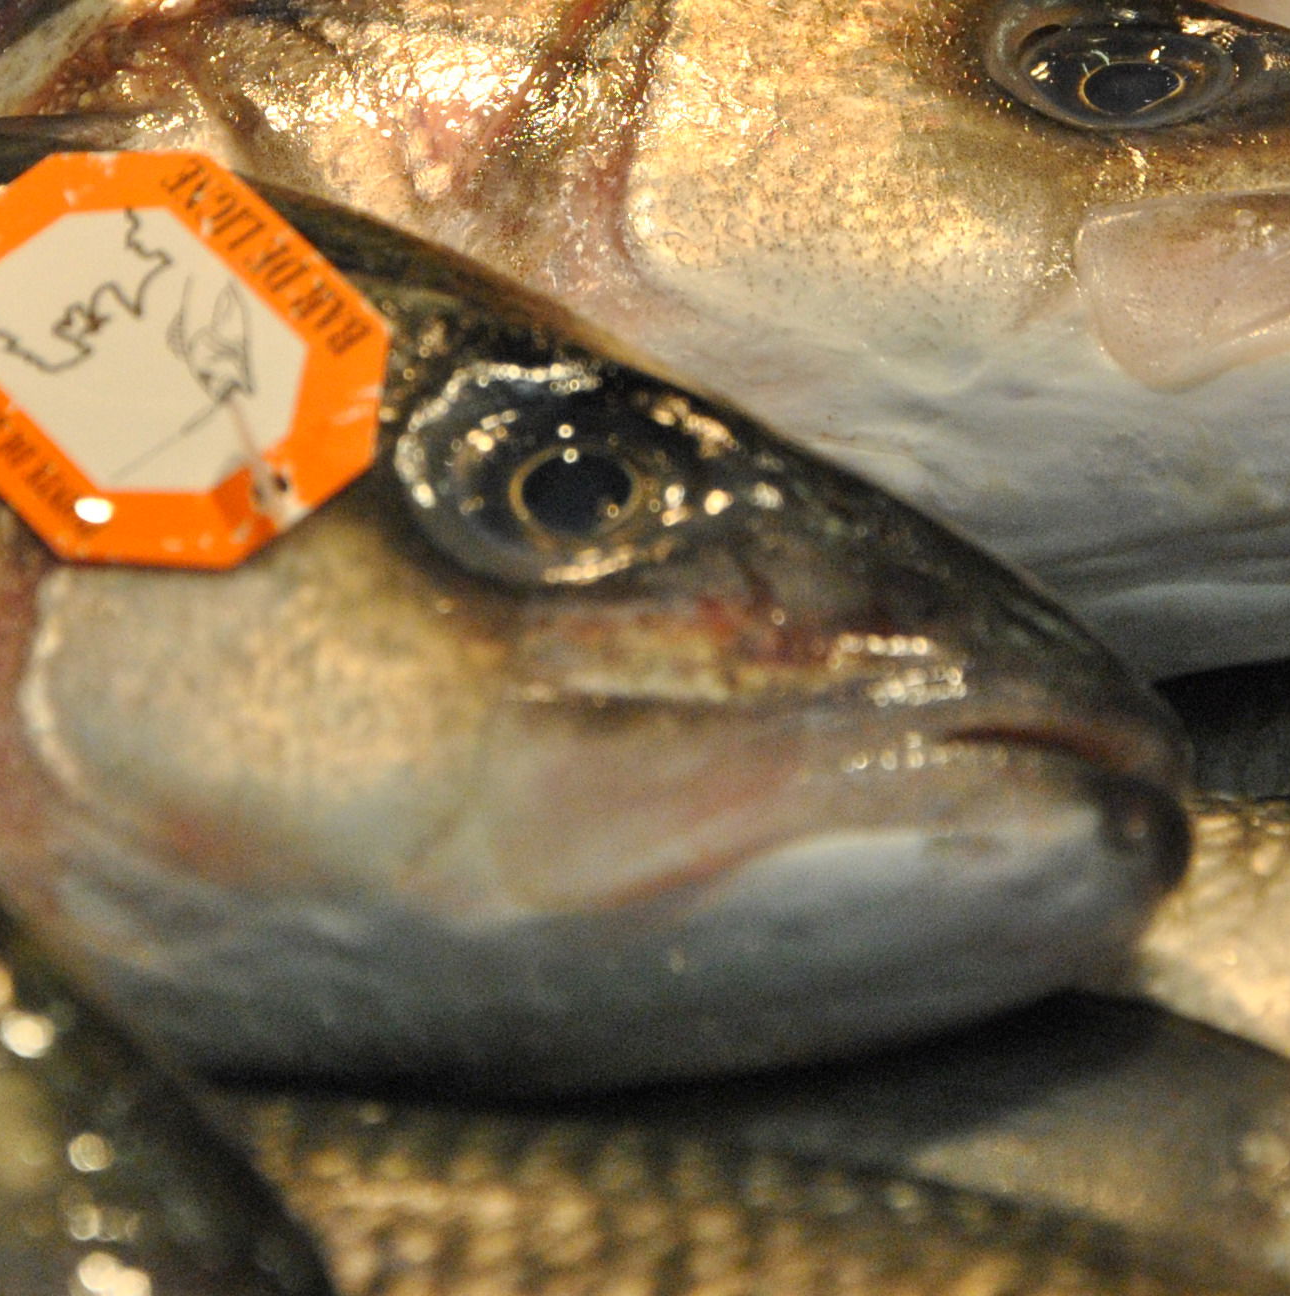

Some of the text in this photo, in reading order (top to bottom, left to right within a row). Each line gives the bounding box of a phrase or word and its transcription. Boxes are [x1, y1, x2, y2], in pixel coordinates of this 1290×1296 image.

[161, 159, 372, 357] BAR DE LIGNE
